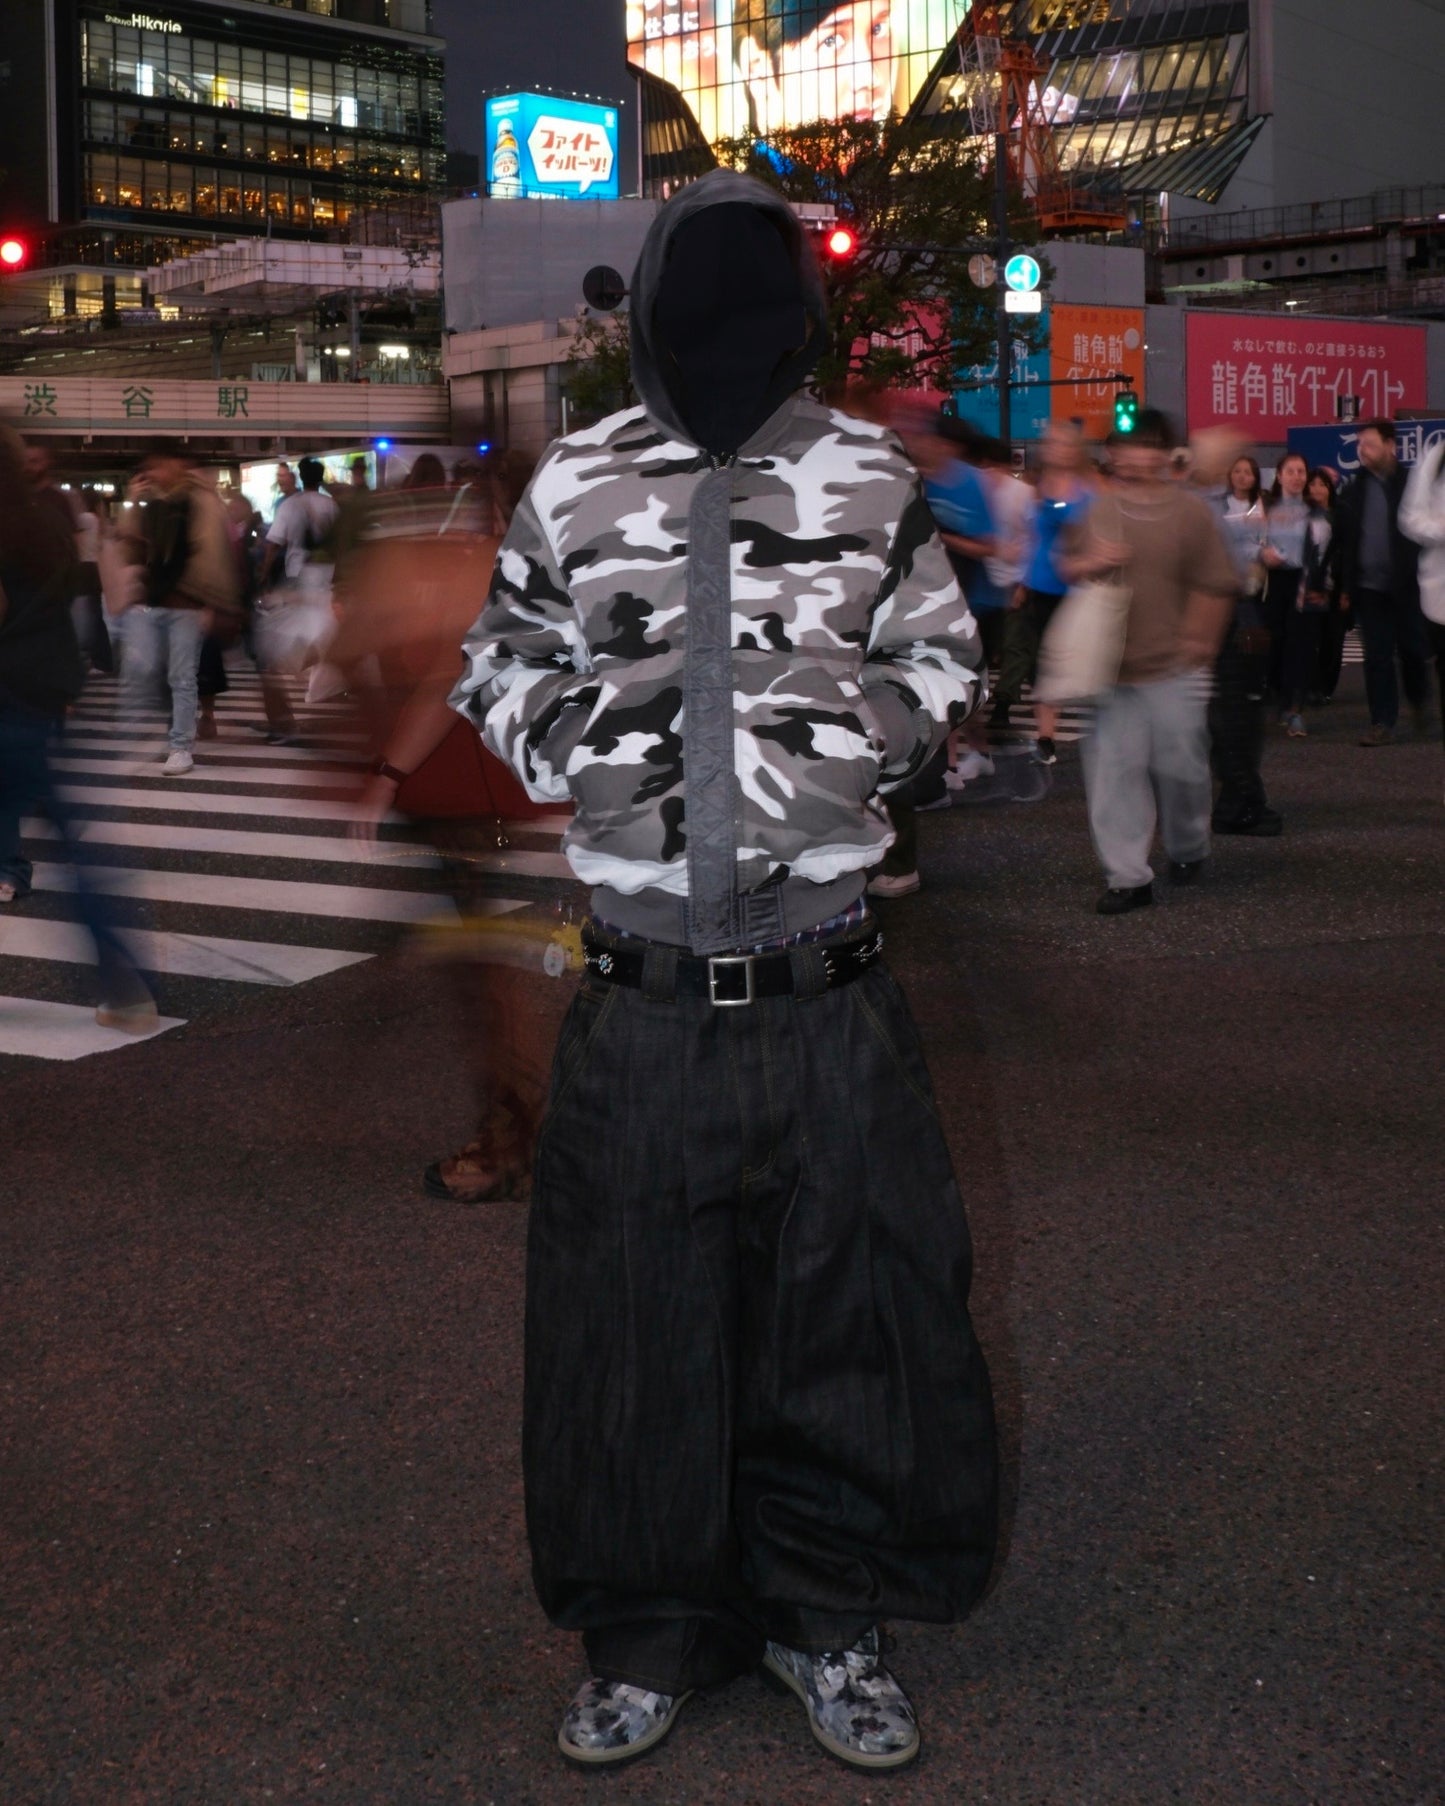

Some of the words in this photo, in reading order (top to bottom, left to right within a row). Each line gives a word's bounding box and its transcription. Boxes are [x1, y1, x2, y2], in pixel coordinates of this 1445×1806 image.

[131, 13, 182, 33] Hikarie
[540, 129, 600, 151] ファイト
[1073, 333, 1123, 364] 龍角散
[23, 382, 249, 418] 渋谷駅
[1211, 359, 1405, 419] 龍角散ダイレクト
